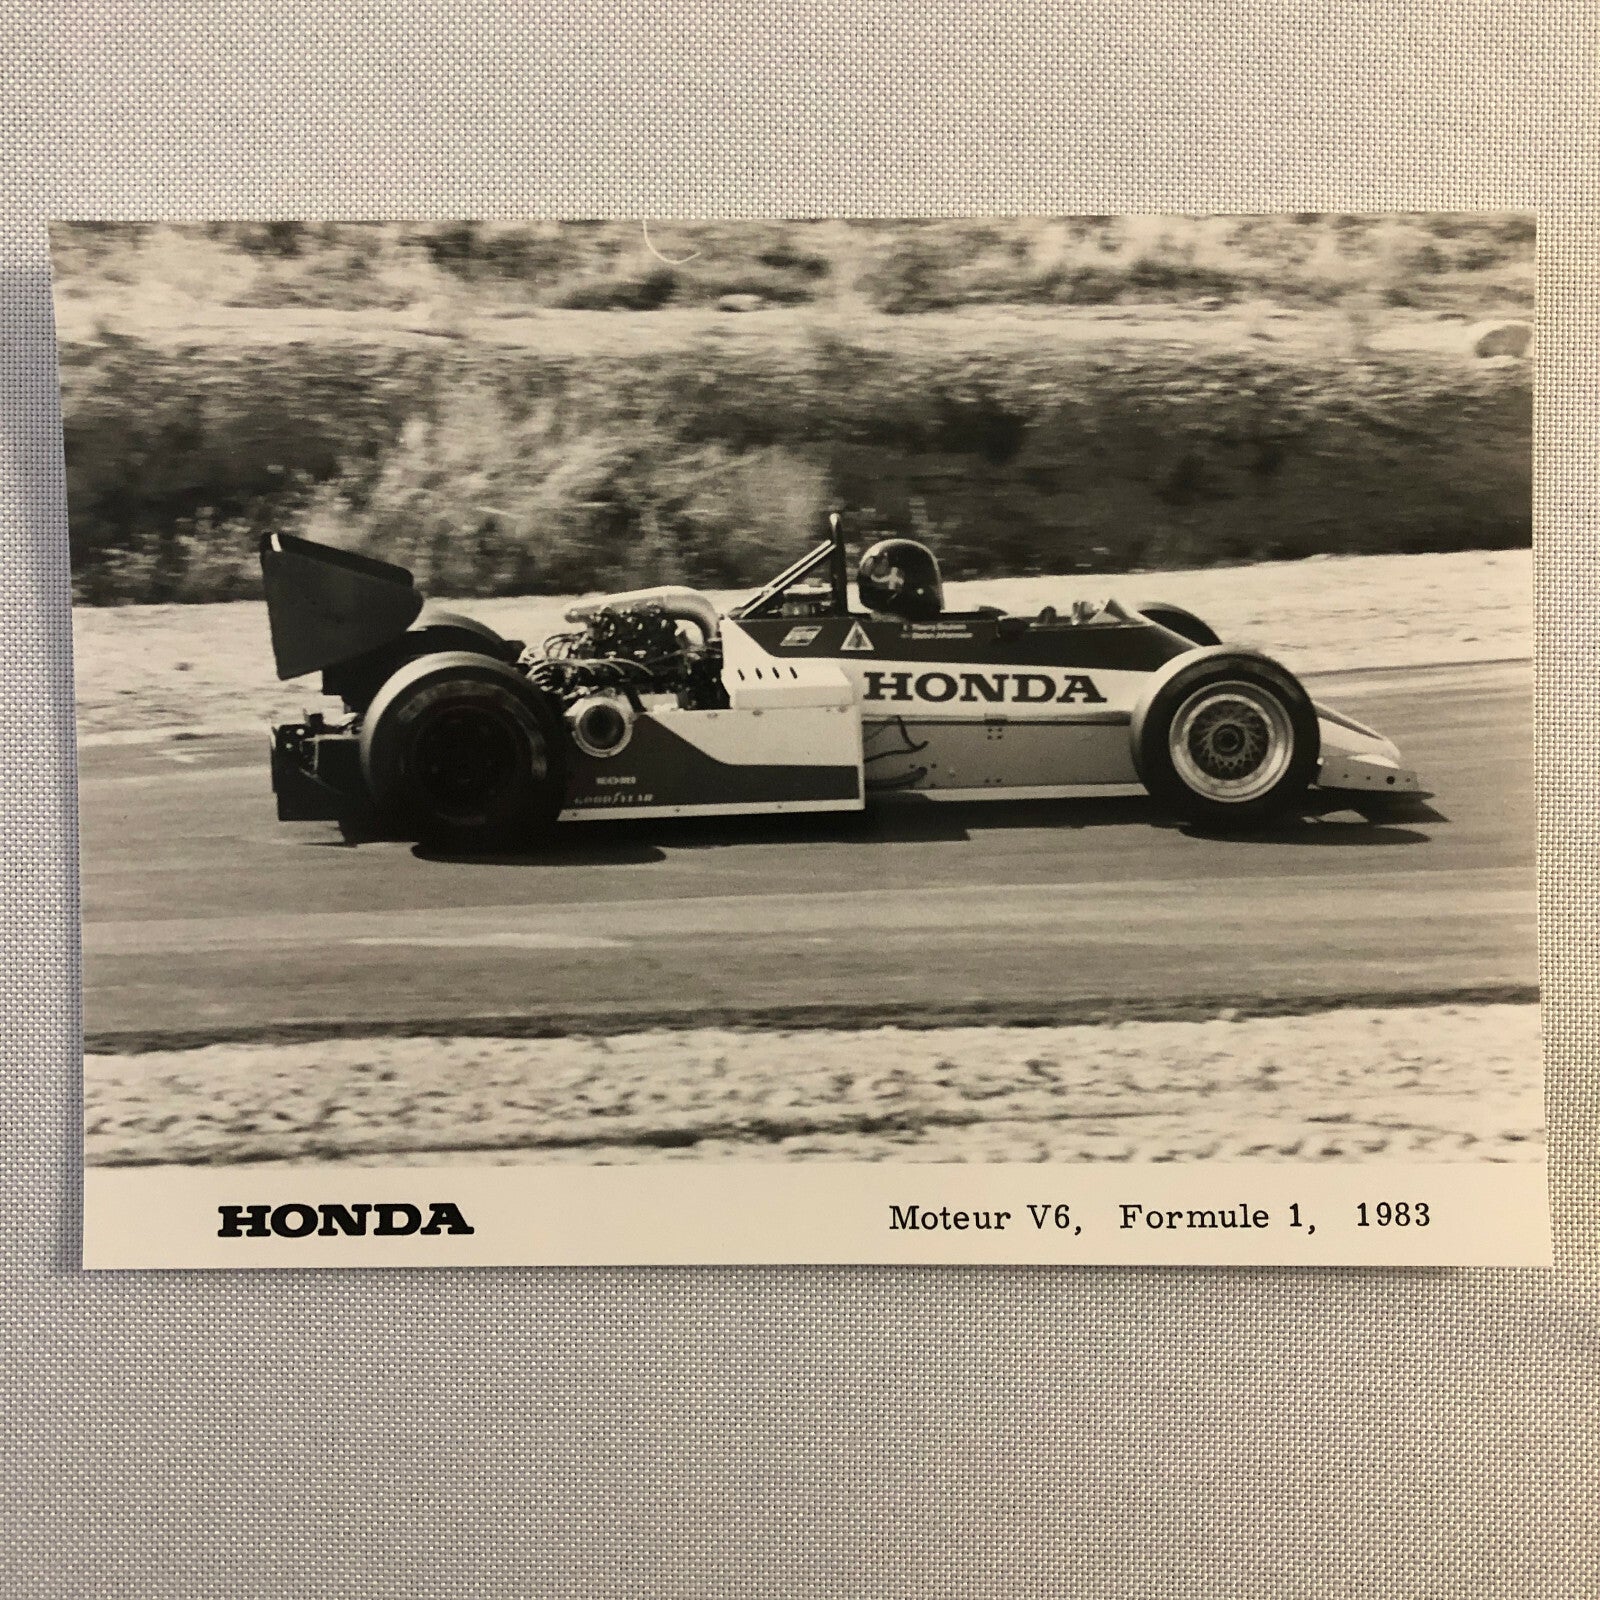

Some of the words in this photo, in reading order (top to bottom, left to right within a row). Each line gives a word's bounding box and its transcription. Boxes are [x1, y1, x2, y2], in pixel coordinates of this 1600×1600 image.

[863, 671, 1108, 704] HONDA
[217, 1203, 475, 1238] HONDA
[889, 1206, 1012, 1231] Moteur
[1027, 1204, 1082, 1236] V6,
[1119, 1204, 1269, 1230] Formule
[1289, 1203, 1316, 1235] 1,
[1356, 1202, 1431, 1228] 1983
